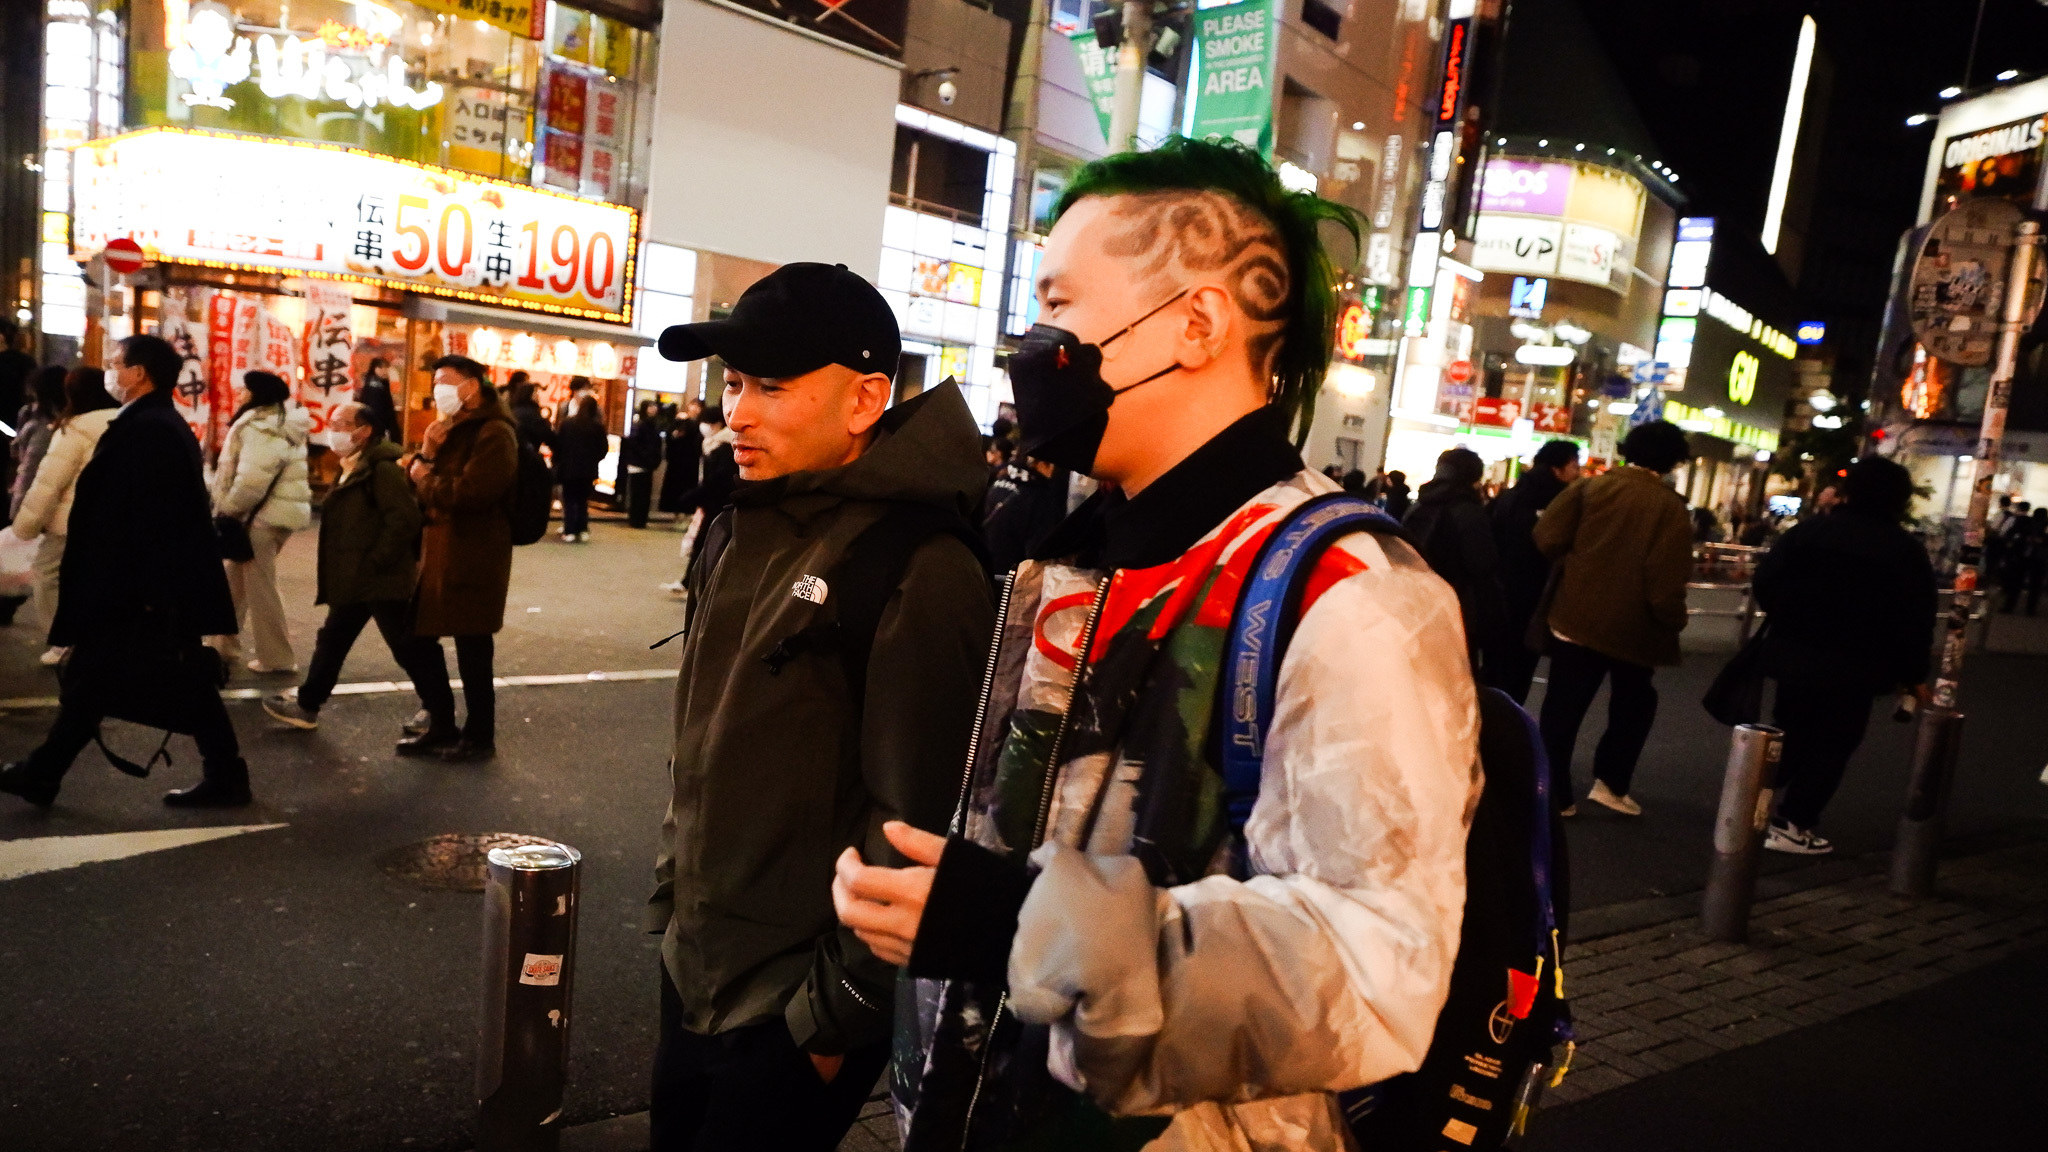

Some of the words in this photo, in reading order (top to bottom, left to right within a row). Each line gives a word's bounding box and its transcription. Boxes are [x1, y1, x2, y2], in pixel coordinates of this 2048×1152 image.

[1203, 9, 1265, 37] PLEASE
[1205, 32, 1264, 59] SMOKE
[1204, 66, 1264, 96] AREA
[1945, 119, 2045, 168] ORIGINALS
[354, 194, 384, 261] 伝串
[486, 219, 512, 281] 生中
[1515, 236, 1553, 261] UP
[311, 308, 351, 397] 伝串
[792, 581, 815, 593] NORTH
[802, 574, 816, 585] THE
[792, 589, 812, 601] FACE
[1233, 600, 1272, 757] WEST
